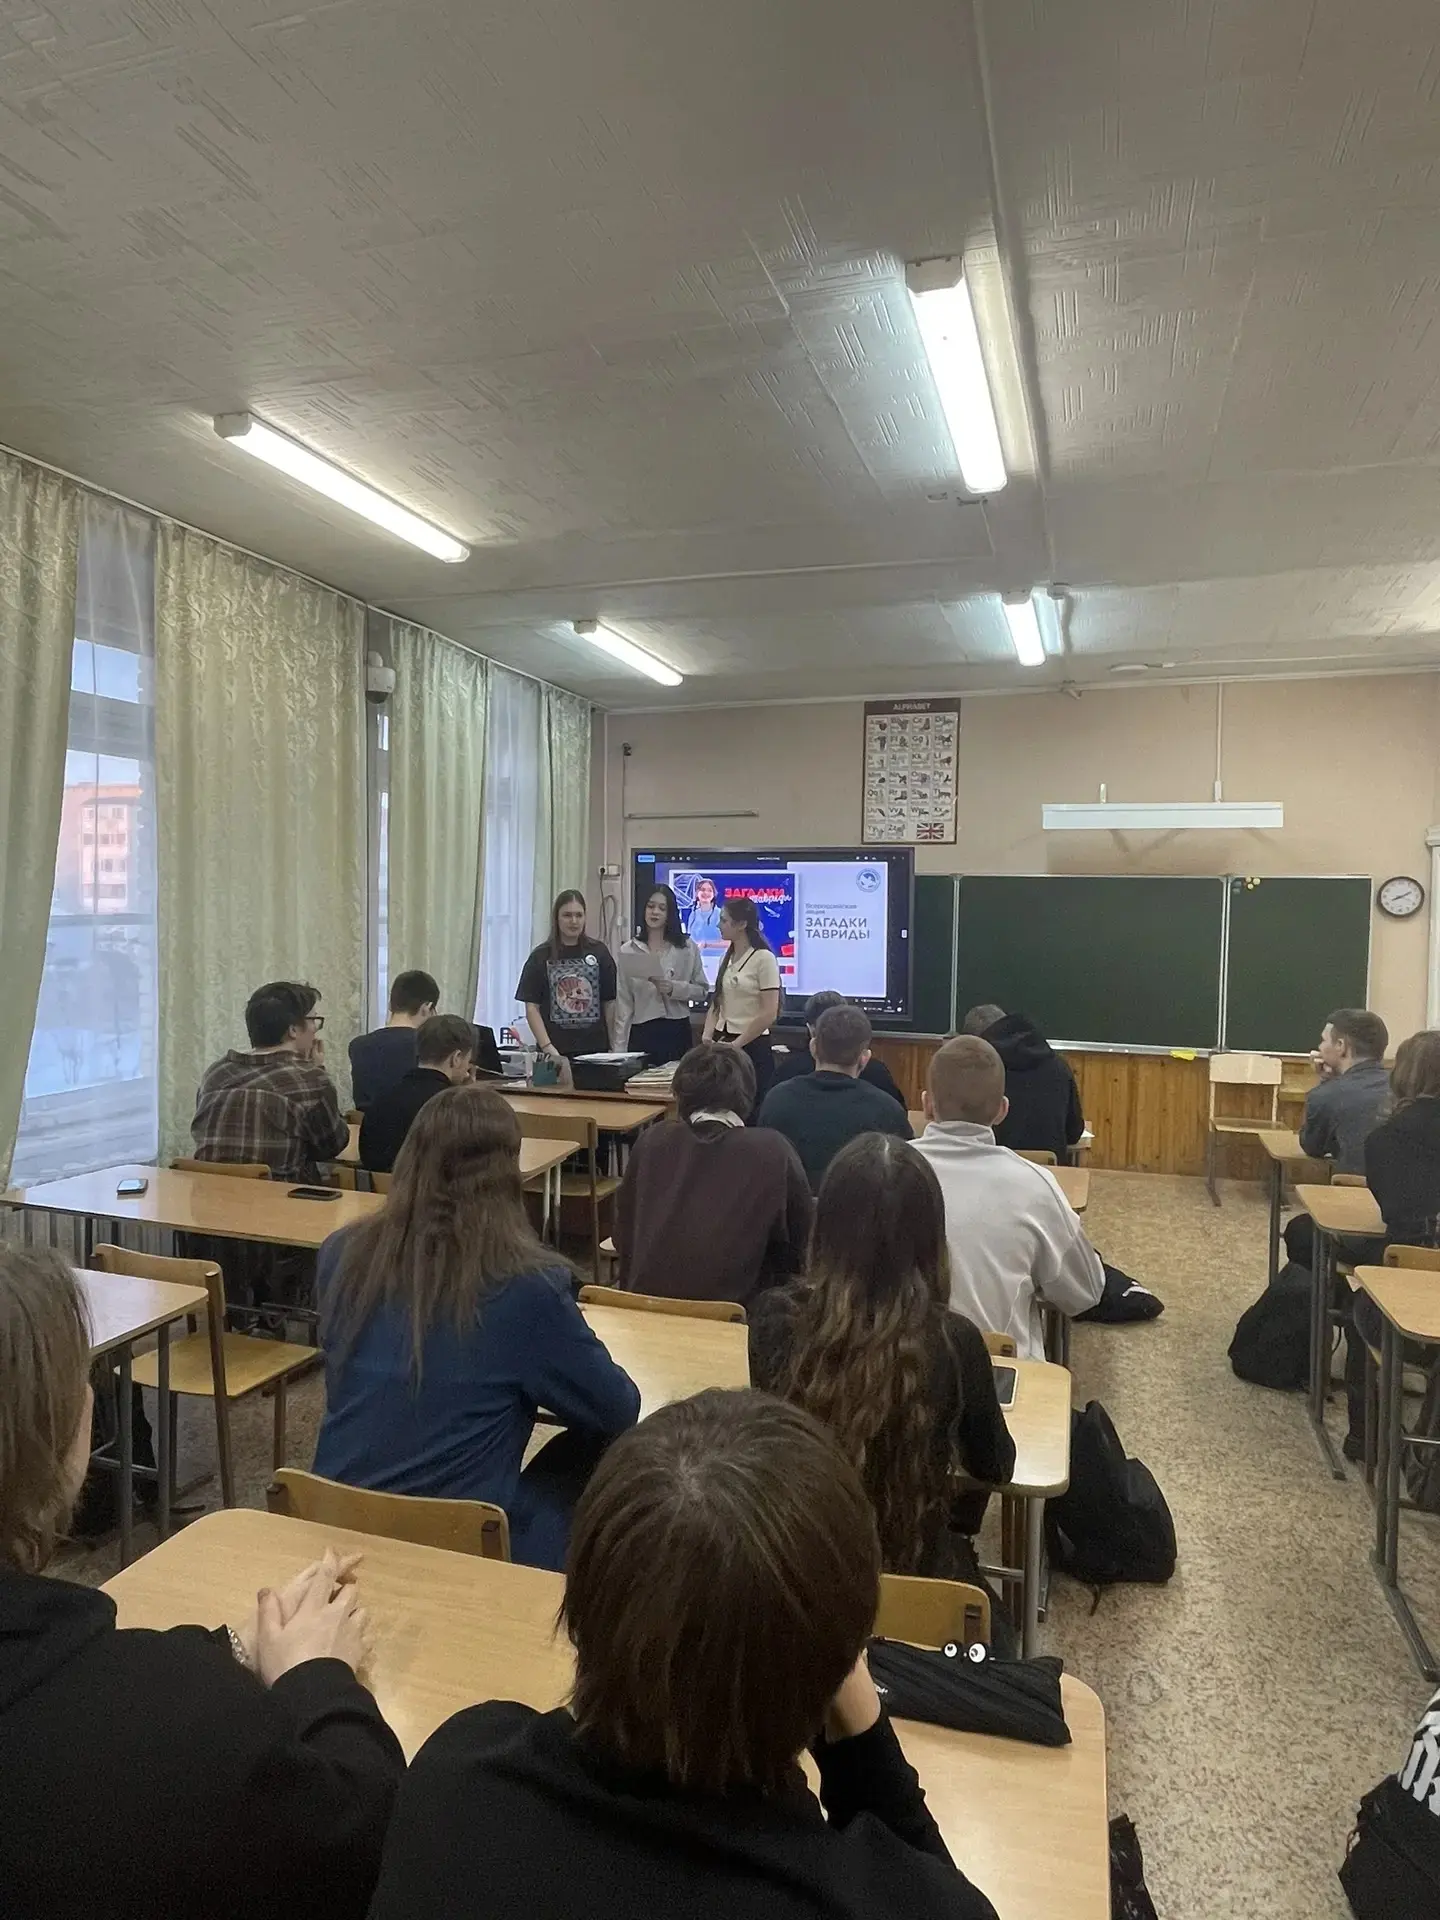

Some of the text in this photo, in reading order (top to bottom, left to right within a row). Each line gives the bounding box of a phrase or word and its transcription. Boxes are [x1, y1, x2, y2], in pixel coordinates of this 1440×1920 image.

[892, 702, 931, 711] ALPHABET
[805, 917, 867, 928] ЗАГАДКИ
[805, 929, 870, 940] ТАВРИДЫ
